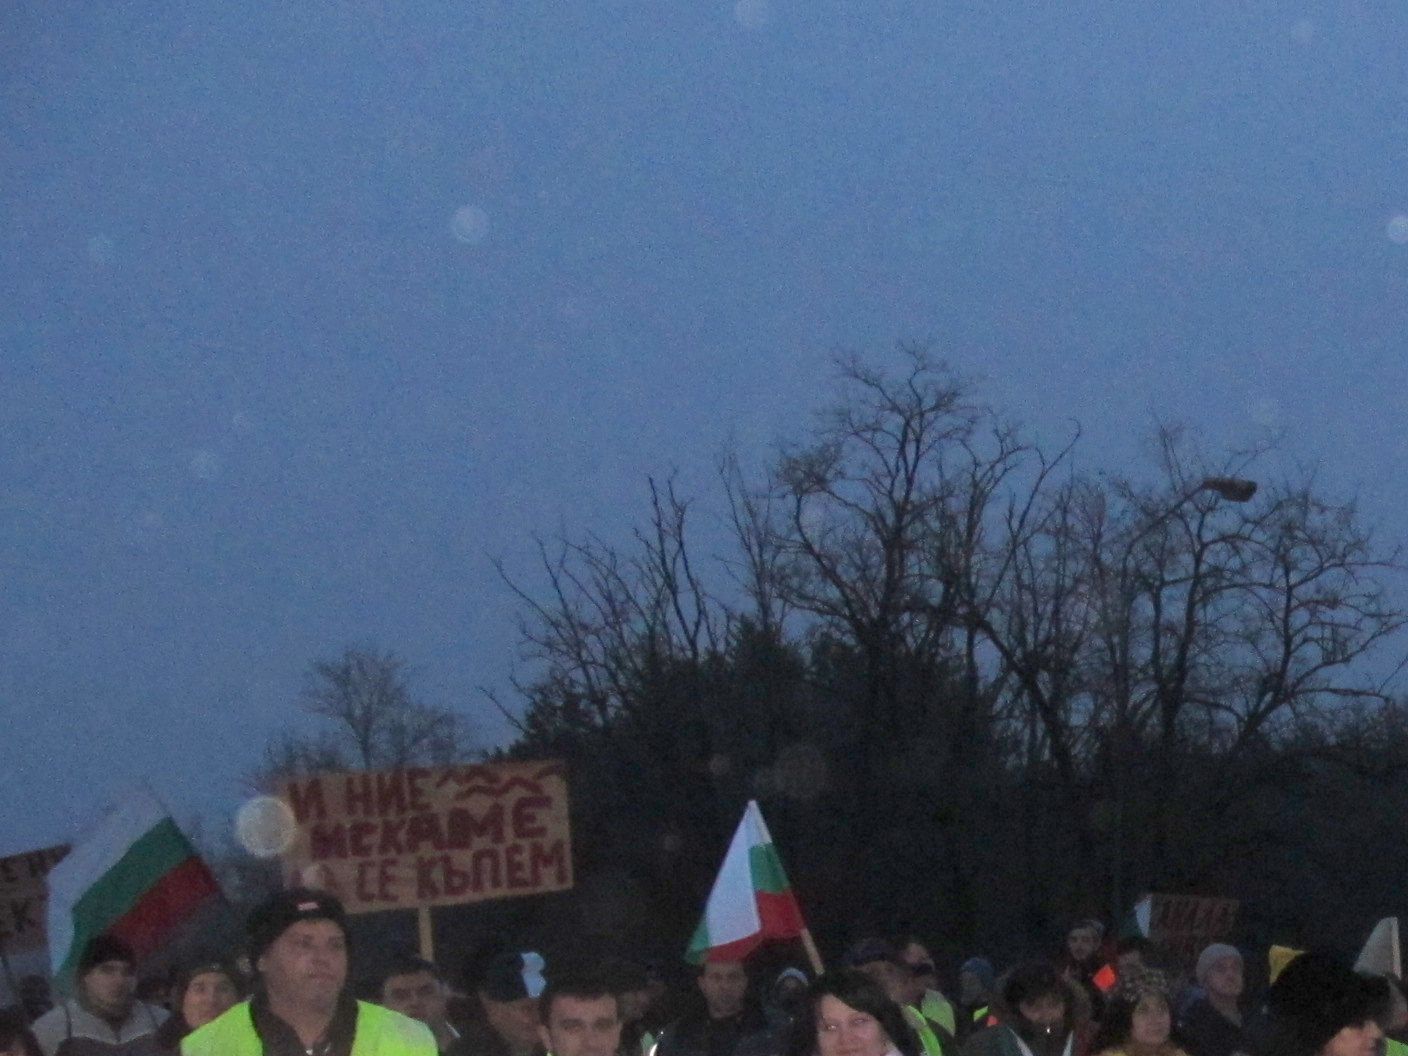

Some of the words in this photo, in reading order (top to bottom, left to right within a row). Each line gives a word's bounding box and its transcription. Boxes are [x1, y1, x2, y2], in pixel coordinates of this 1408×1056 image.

[287, 776, 327, 825] И
[346, 767, 432, 816] НИЕ
[310, 796, 553, 860] ИСКАМЕ
[355, 857, 402, 901] СЕ
[416, 838, 570, 899] КЪПЕМ
